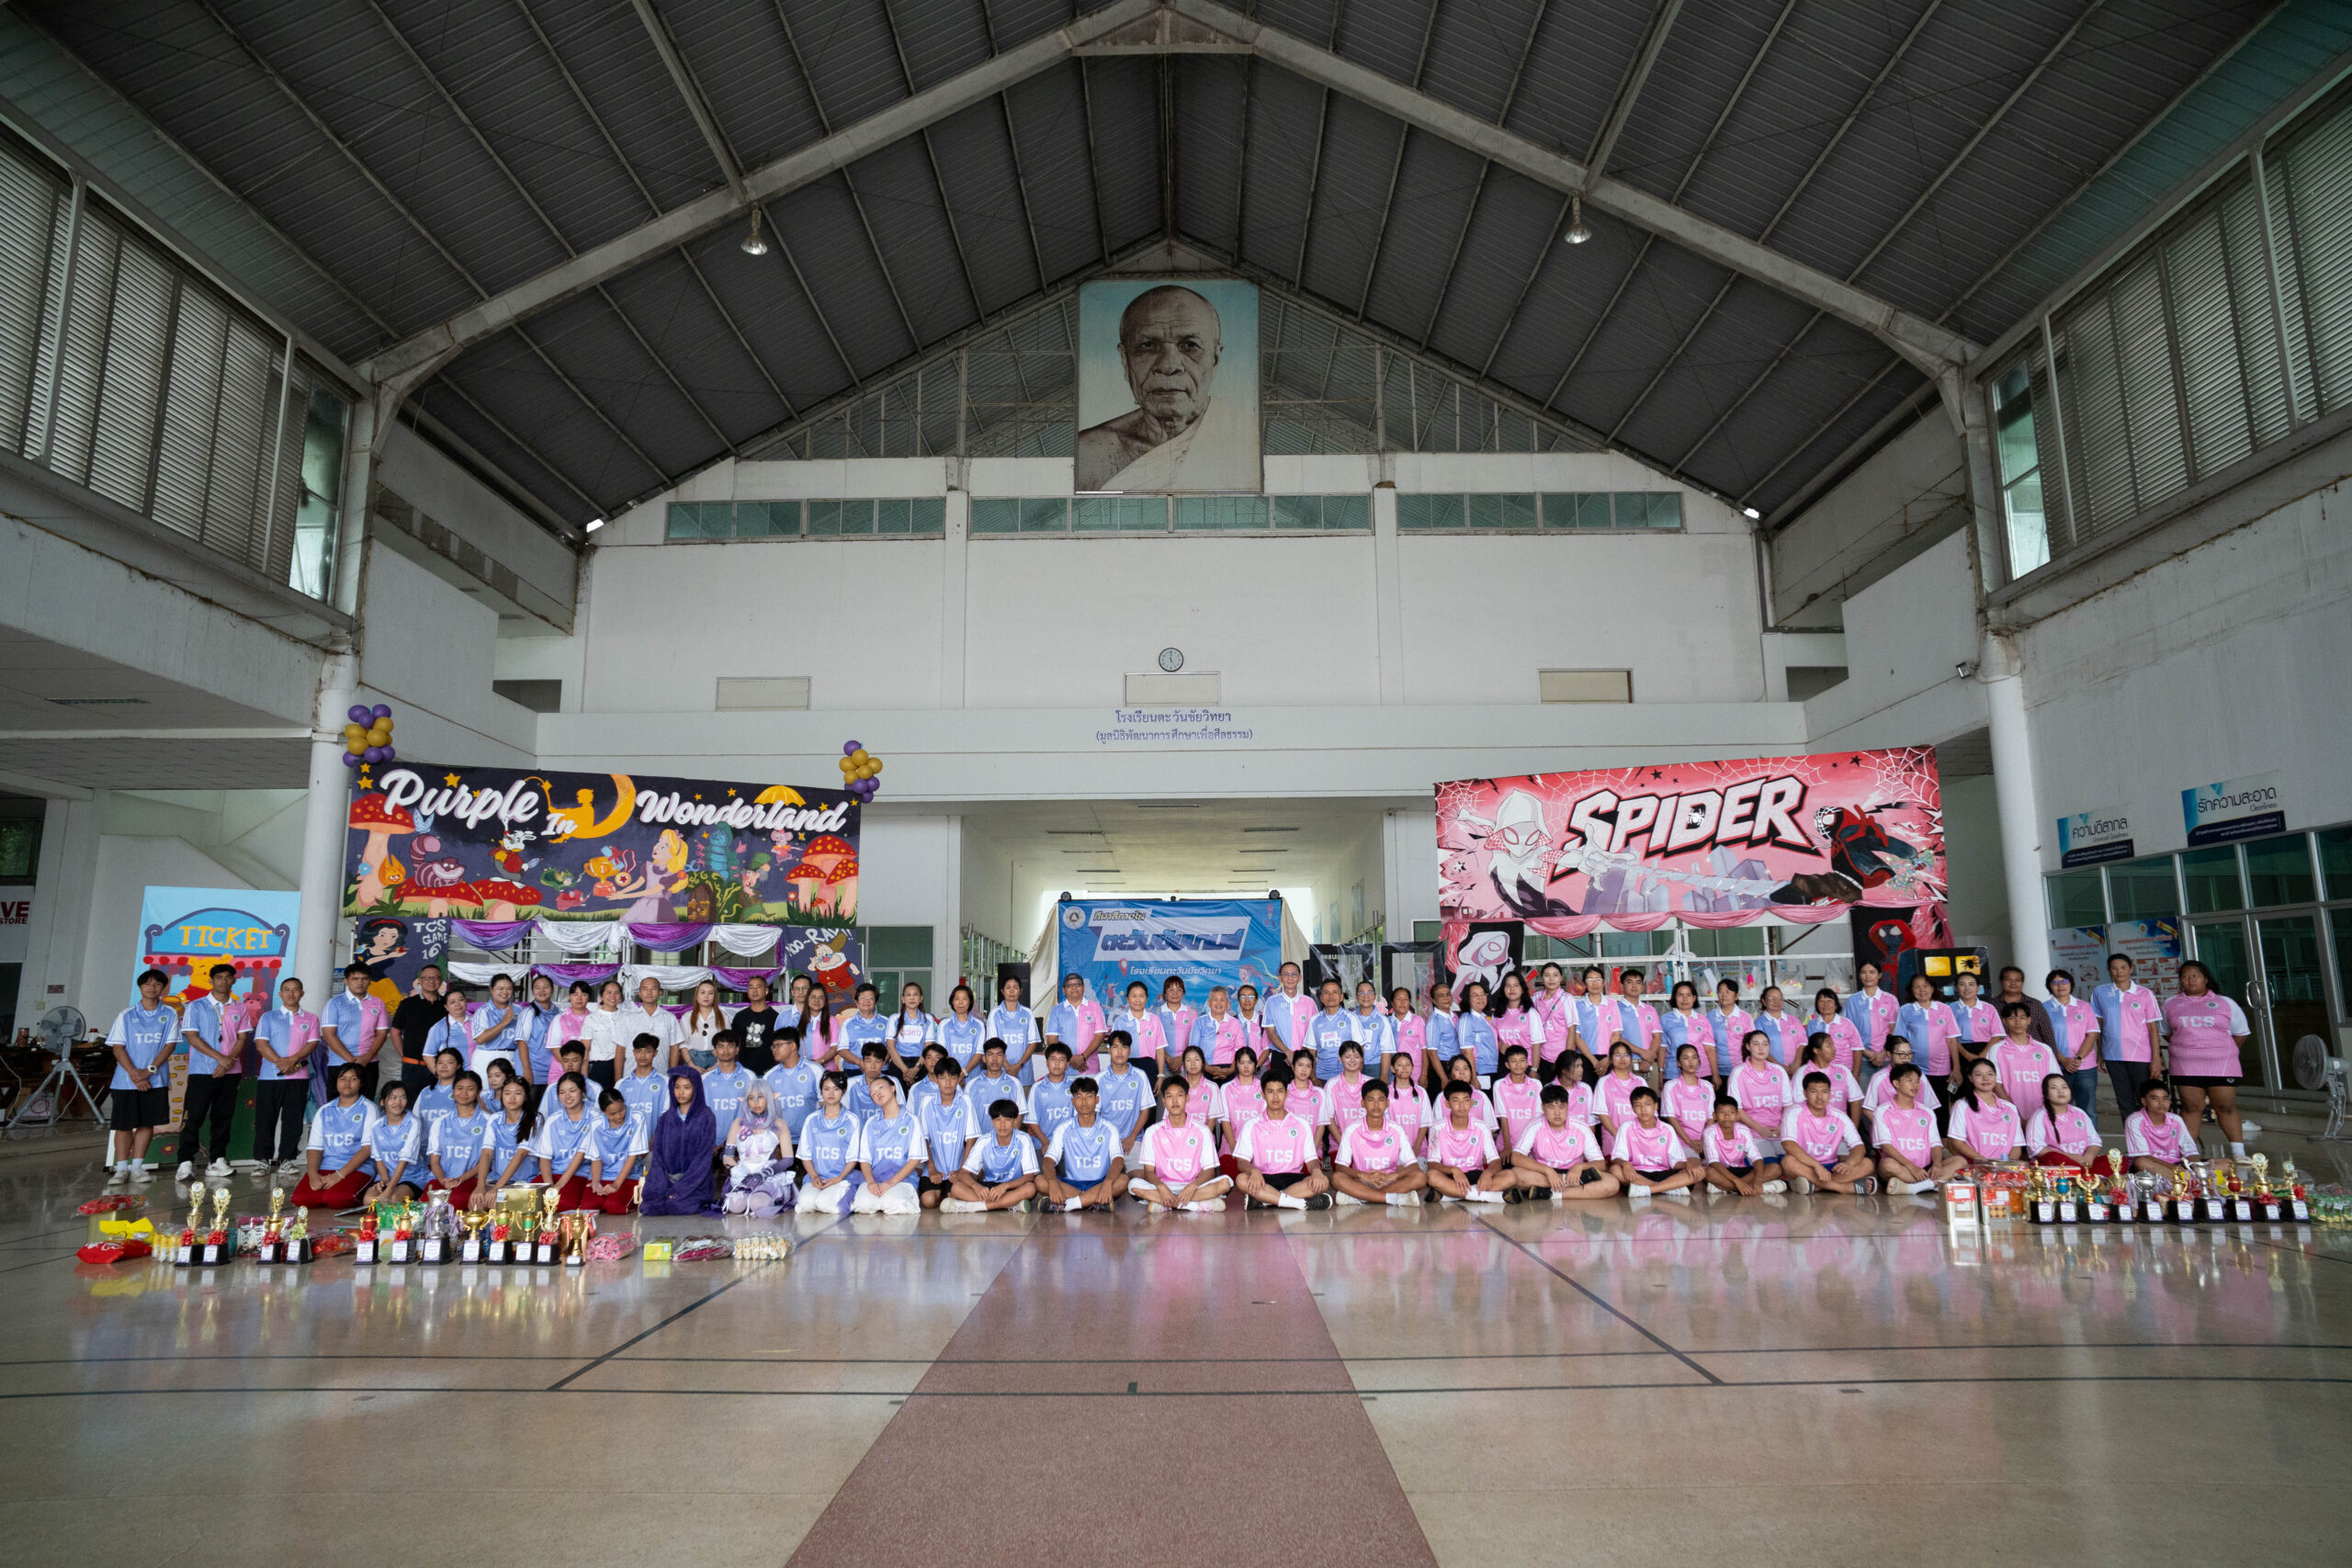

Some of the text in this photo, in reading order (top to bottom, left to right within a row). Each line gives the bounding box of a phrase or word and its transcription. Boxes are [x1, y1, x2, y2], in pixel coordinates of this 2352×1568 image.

[379, 769, 847, 835] Purple In Wonderland
[2198, 787, 2277, 813] รักความสะอาด
[1550, 775, 1824, 879] SPIDER
[2073, 818, 2128, 839] ความดีสากล
[413, 919, 447, 932] TCS
[179, 926, 273, 950] TICKET
[422, 943, 442, 959] 16
[2178, 1015, 2213, 1028] TCS
[135, 1032, 162, 1043] TCS
[1002, 1033, 1023, 1043] TCS
[950, 1043, 972, 1054] TCS
[2013, 1070, 2039, 1082] TCS
[712, 1099, 737, 1111] TCS
[778, 1095, 804, 1109] TCS
[1110, 1100, 1134, 1111] TCS
[1752, 1095, 1778, 1108] TCS
[1046, 1106, 1069, 1120] TCS
[1342, 1108, 1364, 1119] TCS
[1510, 1109, 1531, 1119] TCS
[1614, 1103, 1630, 1115] TC
[1395, 1114, 1417, 1124] TCS
[1681, 1111, 1704, 1121] TCS
[324, 1134, 354, 1146] TCS
[936, 1131, 957, 1145] TCS
[1897, 1138, 1924, 1150] TCS
[1980, 1133, 2007, 1146] TCS
[447, 1145, 471, 1158] TCS
[815, 1146, 839, 1159] TCS
[875, 1146, 901, 1160] TCS
[1805, 1142, 1832, 1156] TCS
[1074, 1156, 1100, 1168] TCS
[1264, 1149, 1293, 1163] TCS
[1166, 1158, 1192, 1171] TCS
[1363, 1156, 1388, 1170] TCS
